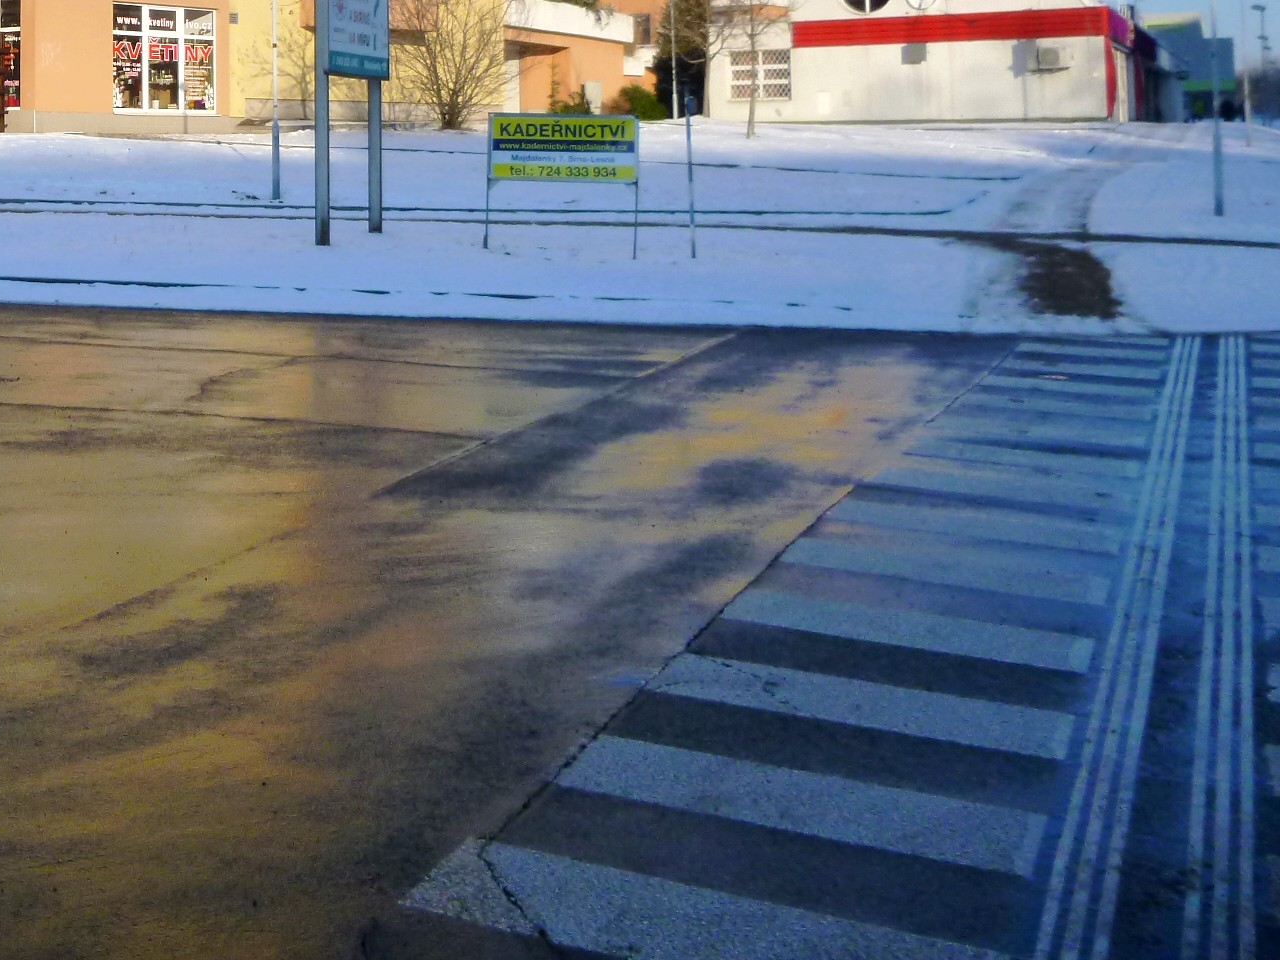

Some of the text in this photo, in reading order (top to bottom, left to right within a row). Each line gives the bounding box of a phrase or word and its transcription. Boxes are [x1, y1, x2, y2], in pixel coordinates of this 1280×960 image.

[113, 37, 212, 62] KVĚTINY
[500, 120, 625, 138] KADEŘNICTVÍ
[510, 166, 616, 177] tel.: 724 333 934
